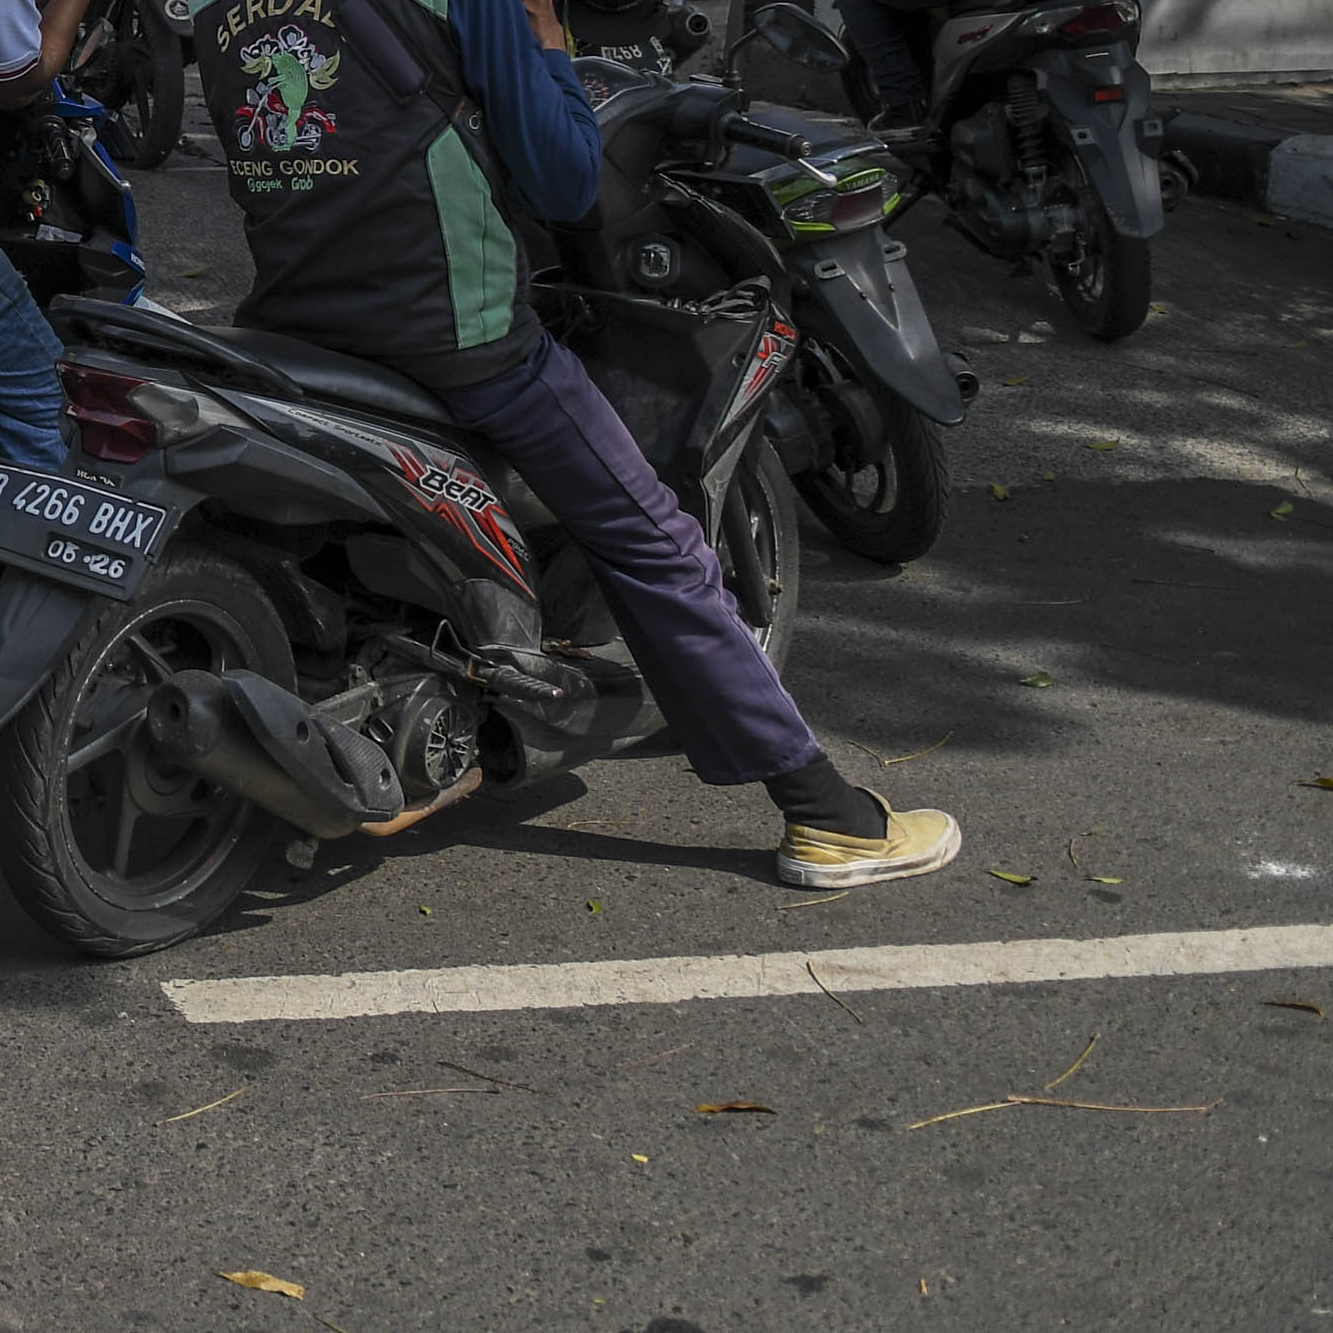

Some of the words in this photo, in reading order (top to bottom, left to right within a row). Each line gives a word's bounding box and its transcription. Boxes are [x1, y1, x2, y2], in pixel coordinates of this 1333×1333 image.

[229, 160, 273, 176] ECENG
[279, 159, 360, 175] GONDOK
[12, 481, 85, 526] 4266
[88, 502, 154, 548] BHX
